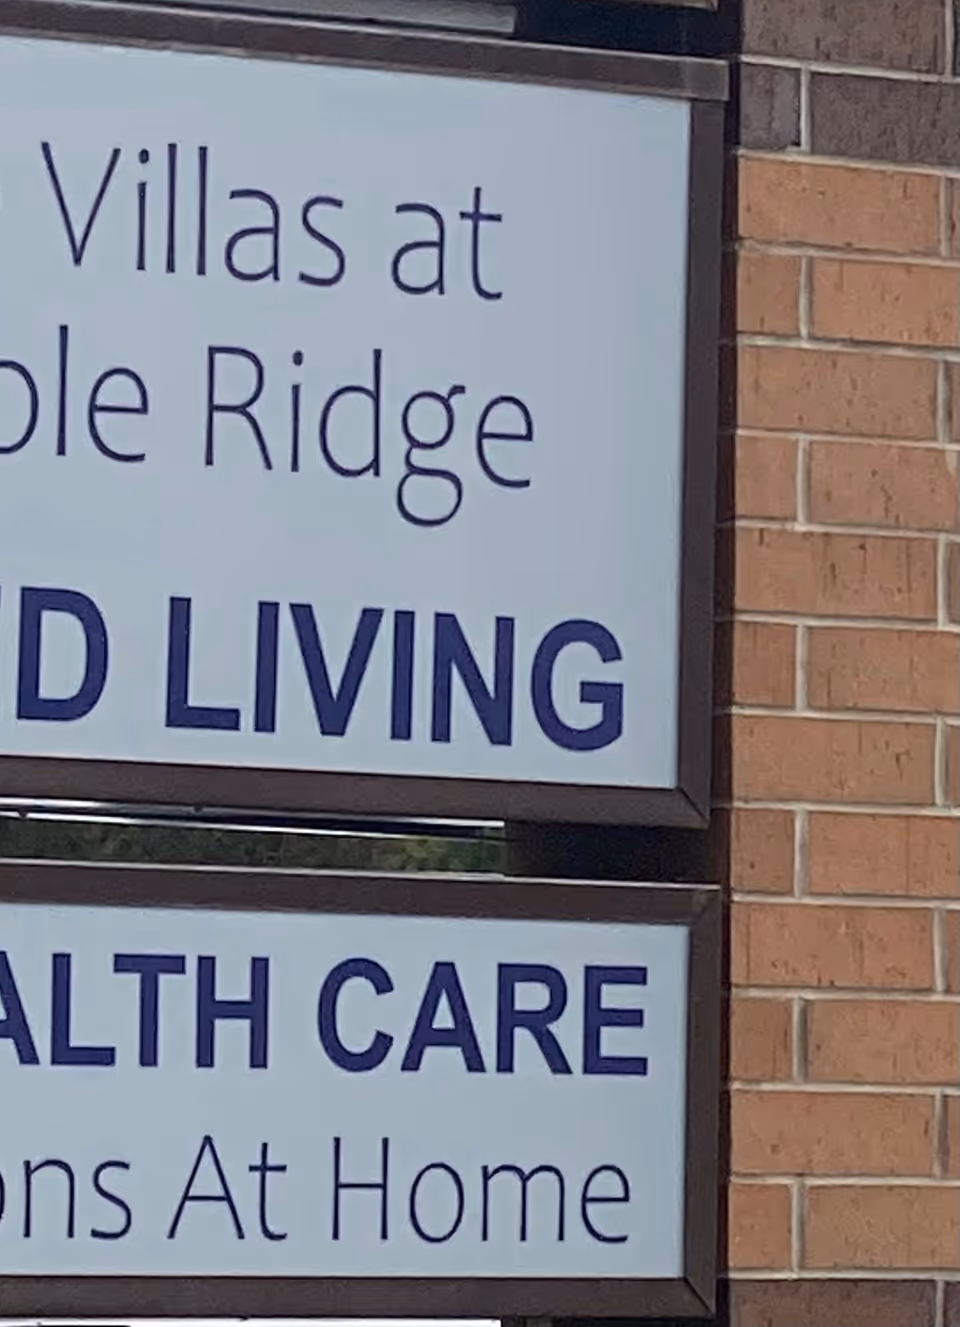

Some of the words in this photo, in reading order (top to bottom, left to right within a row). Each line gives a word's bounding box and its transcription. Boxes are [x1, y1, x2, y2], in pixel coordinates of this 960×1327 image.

[42, 142, 345, 286] Villas
[392, 187, 502, 300] at
[205, 346, 533, 527] Ridge
[165, 596, 624, 752] LIVING
[318, 958, 648, 1076] CARE
[168, 1135, 287, 1241] At
[332, 1137, 630, 1243] Home
